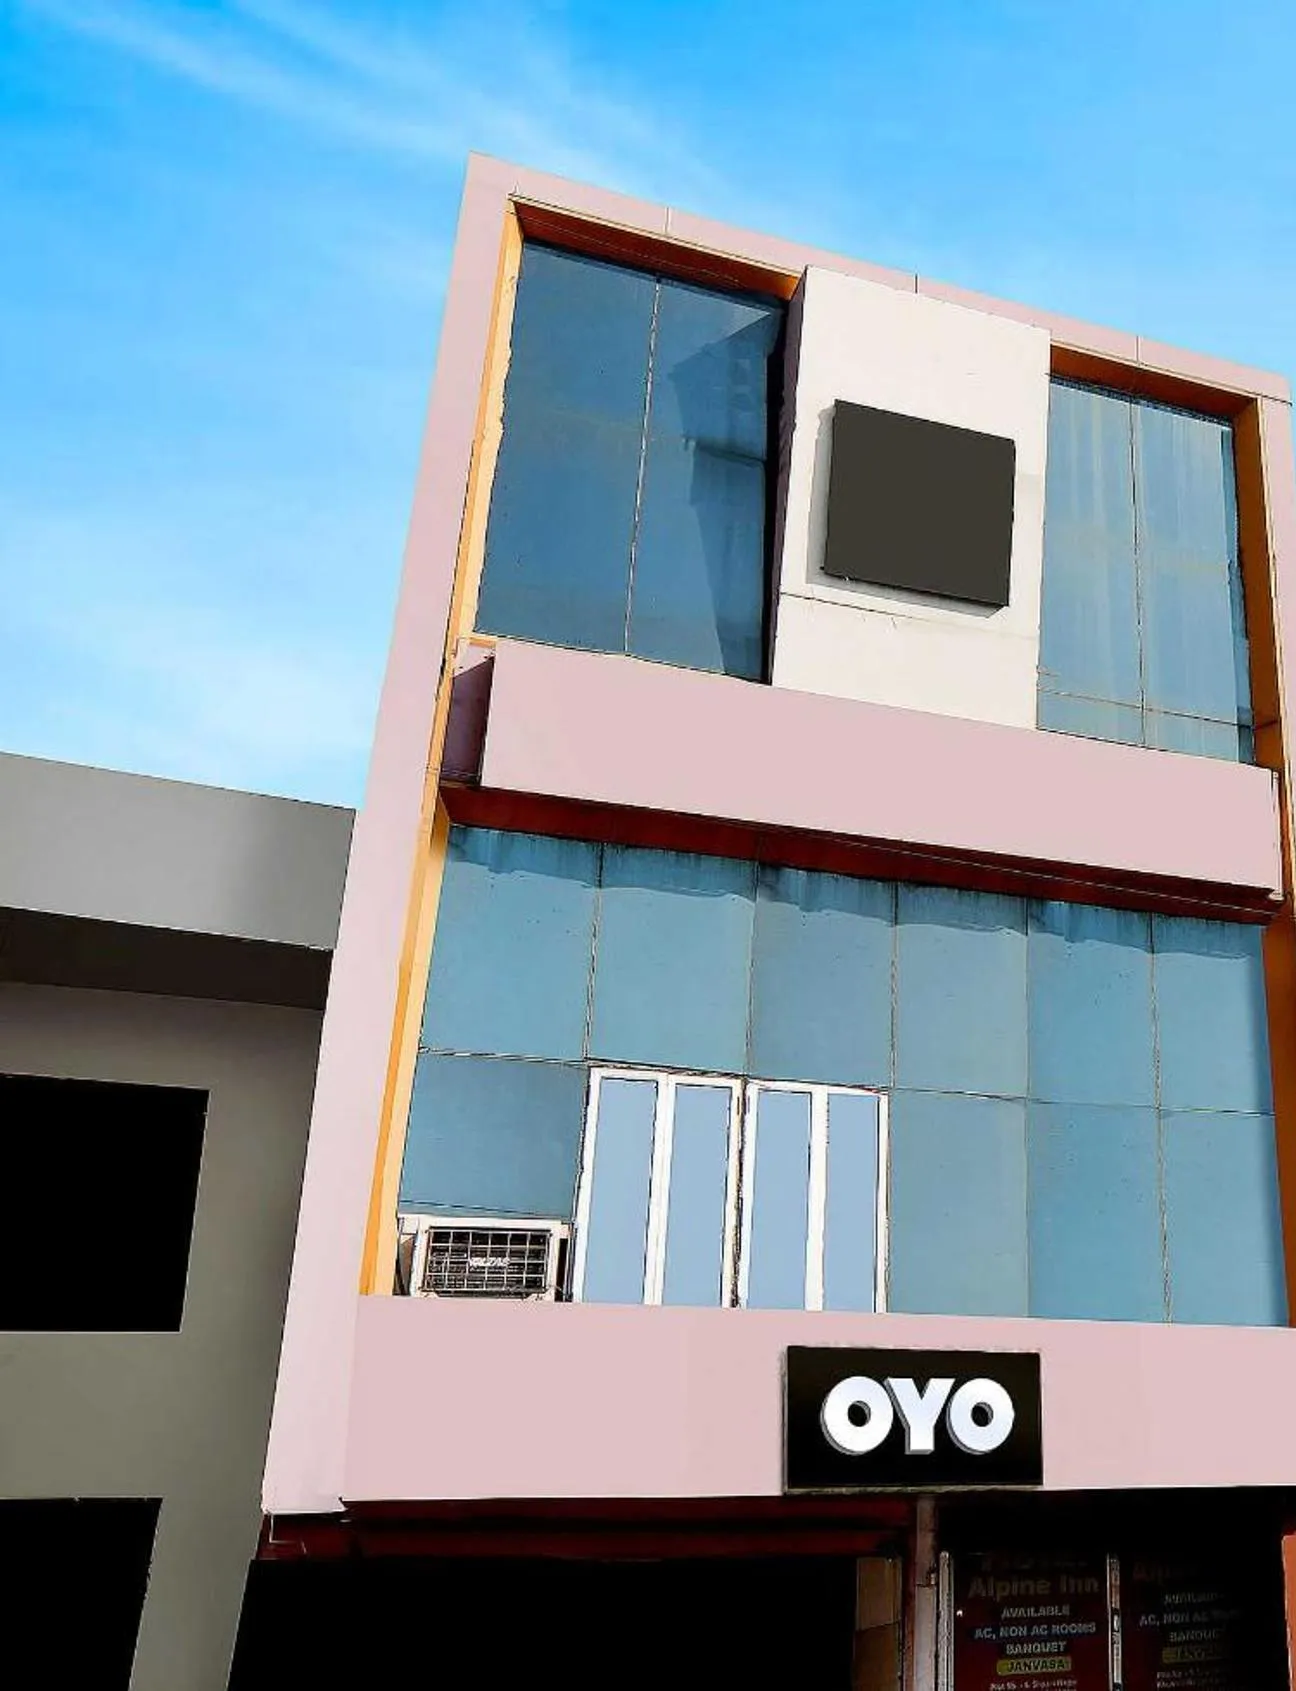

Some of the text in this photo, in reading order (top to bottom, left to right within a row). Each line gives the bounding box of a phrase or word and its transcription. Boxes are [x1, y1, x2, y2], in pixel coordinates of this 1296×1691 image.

[820, 1376, 1015, 1455] OYO
[968, 1574, 1100, 1602] Alpine Inn
[1001, 1604, 1070, 1619] AVAILABLE
[1163, 1612, 1190, 1624] NON
[973, 1622, 1096, 1640] AC, NON AC ROOMS
[1005, 1641, 1067, 1655] BANQUET
[1008, 1658, 1065, 1672] JANVASA
